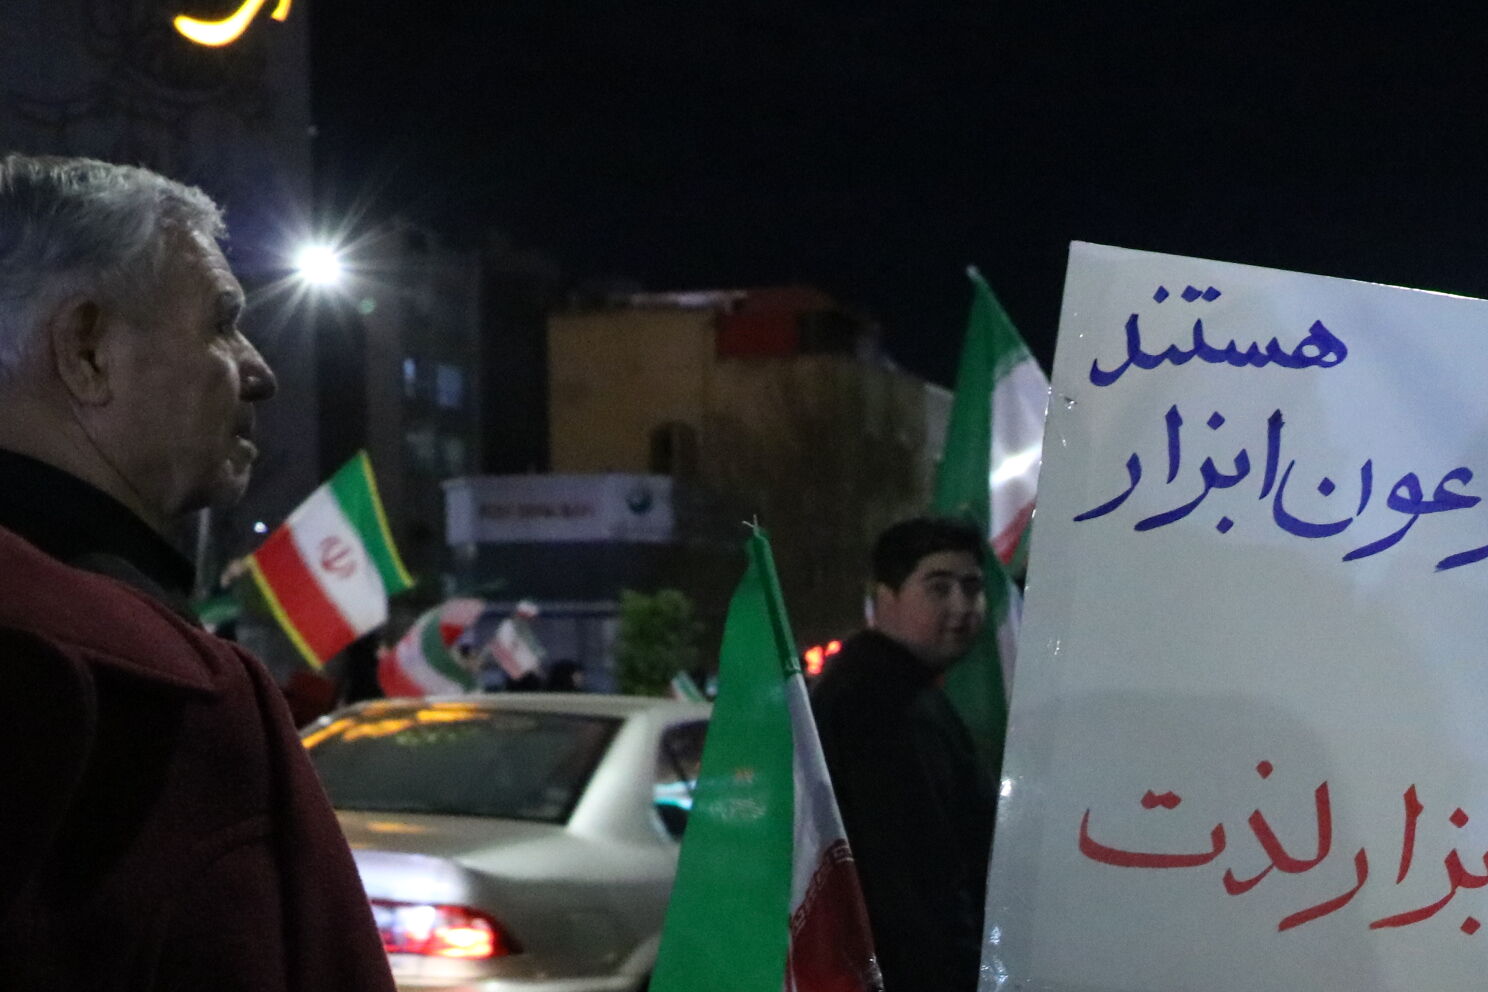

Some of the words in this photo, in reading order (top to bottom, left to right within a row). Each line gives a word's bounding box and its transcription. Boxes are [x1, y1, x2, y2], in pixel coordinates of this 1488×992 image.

[1089, 285, 1350, 388] هستند
[1072, 403, 1287, 535] ابزار
[1078, 758, 1333, 897] لذت
